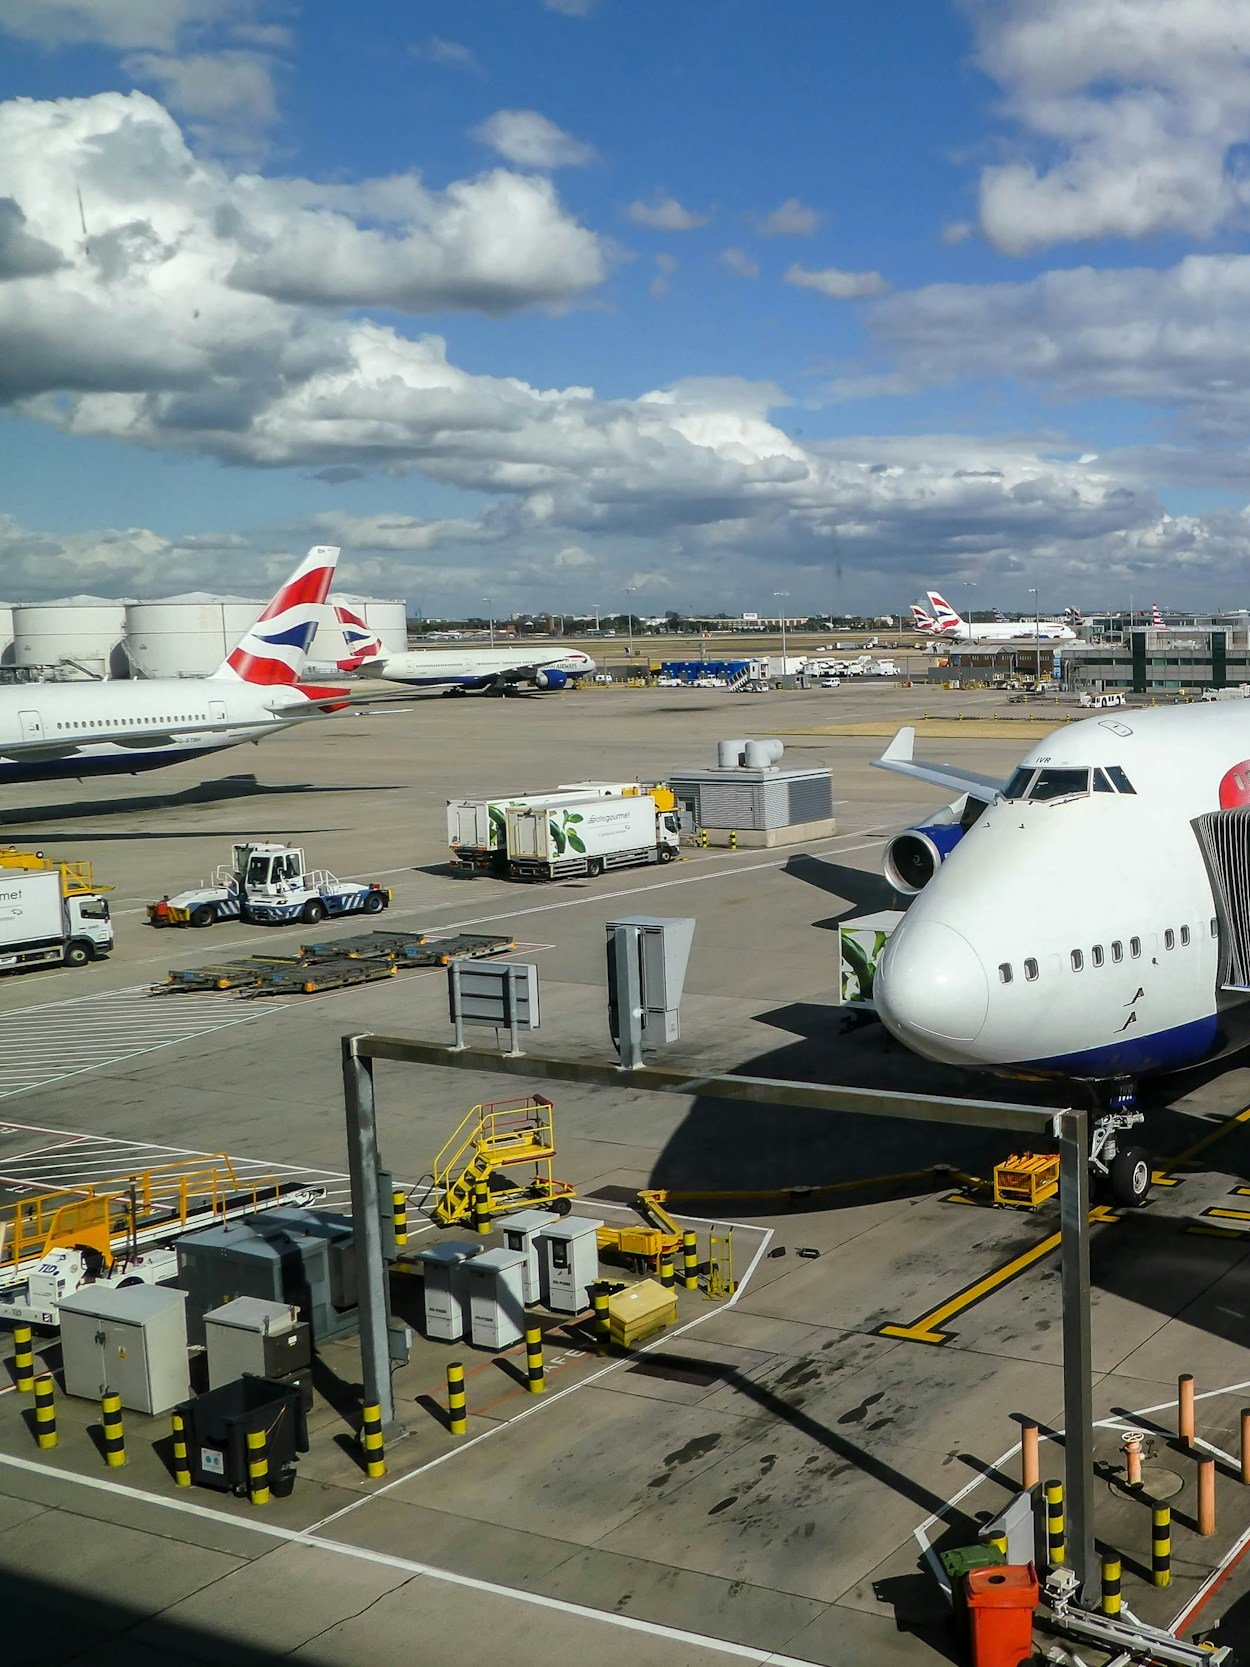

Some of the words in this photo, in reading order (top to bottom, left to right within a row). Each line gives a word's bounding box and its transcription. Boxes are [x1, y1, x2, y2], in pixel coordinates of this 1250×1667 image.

[1035, 756, 1052, 764] IVR
[38, 1264, 58, 1273] TLD
[530, 1349, 587, 1374] AFE
